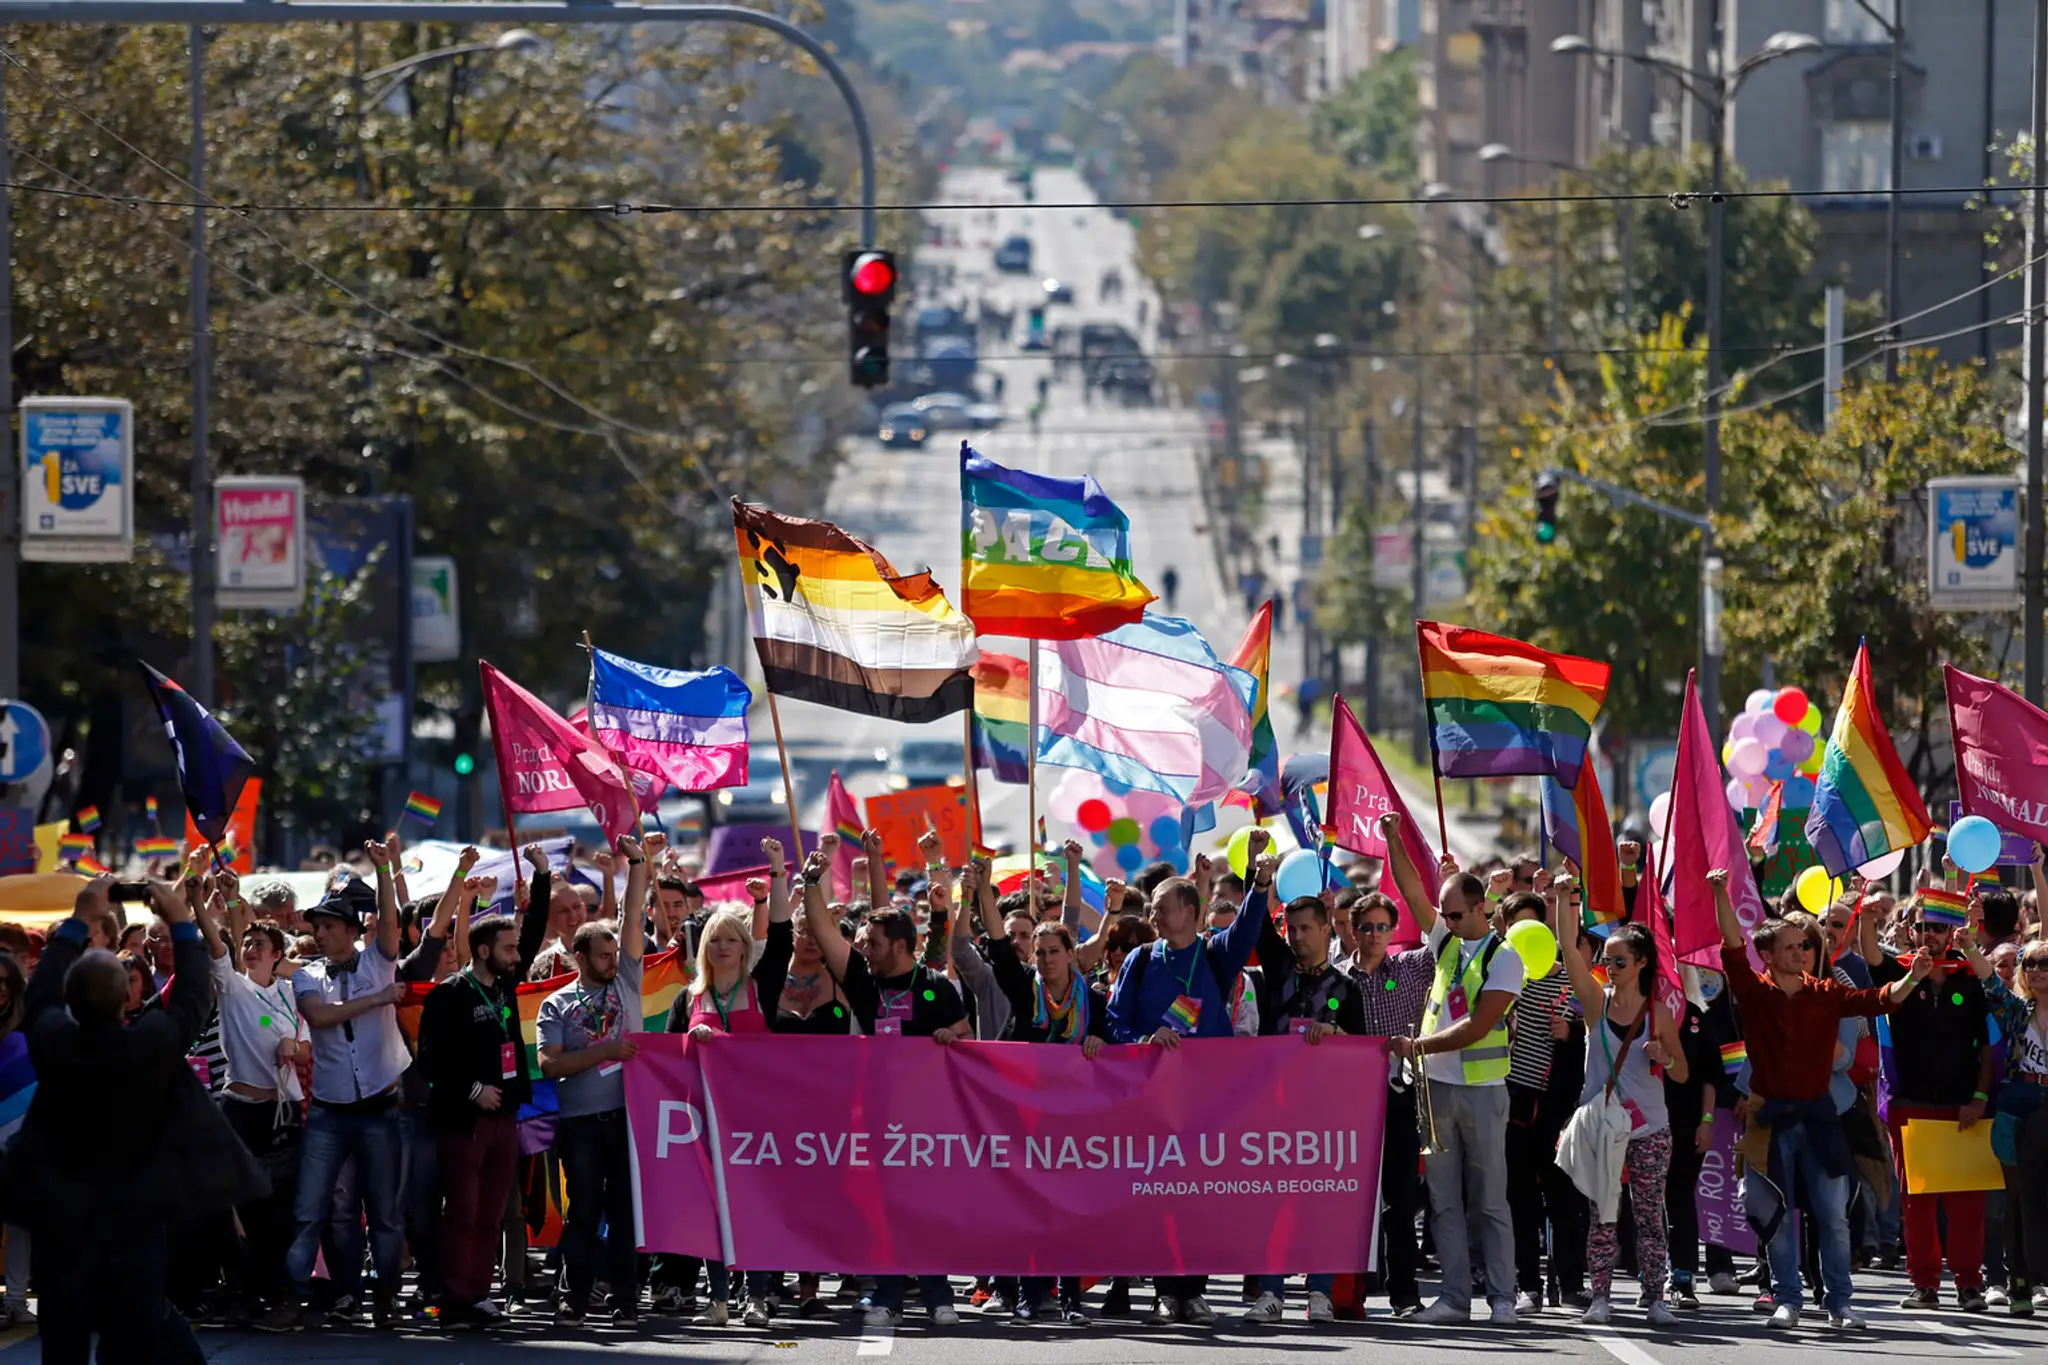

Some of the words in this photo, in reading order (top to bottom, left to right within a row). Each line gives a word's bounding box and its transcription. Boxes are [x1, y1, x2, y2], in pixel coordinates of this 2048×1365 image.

[62, 474, 100, 495] SVE
[1966, 540, 1999, 556] SVE
[729, 1131, 782, 1166] ZA
[795, 1132, 870, 1167] SVE
[882, 1123, 1011, 1168] ŽRTVE
[1025, 1134, 1186, 1176] NASILJA
[1200, 1132, 1226, 1167] U
[1240, 1130, 1358, 1172] SRBIJI
[1698, 1149, 1725, 1201] ROD
[1132, 1182, 1200, 1196] PARADA
[1203, 1180, 1274, 1195] PONOSA
[1277, 1178, 1359, 1193] BEOGRAD
